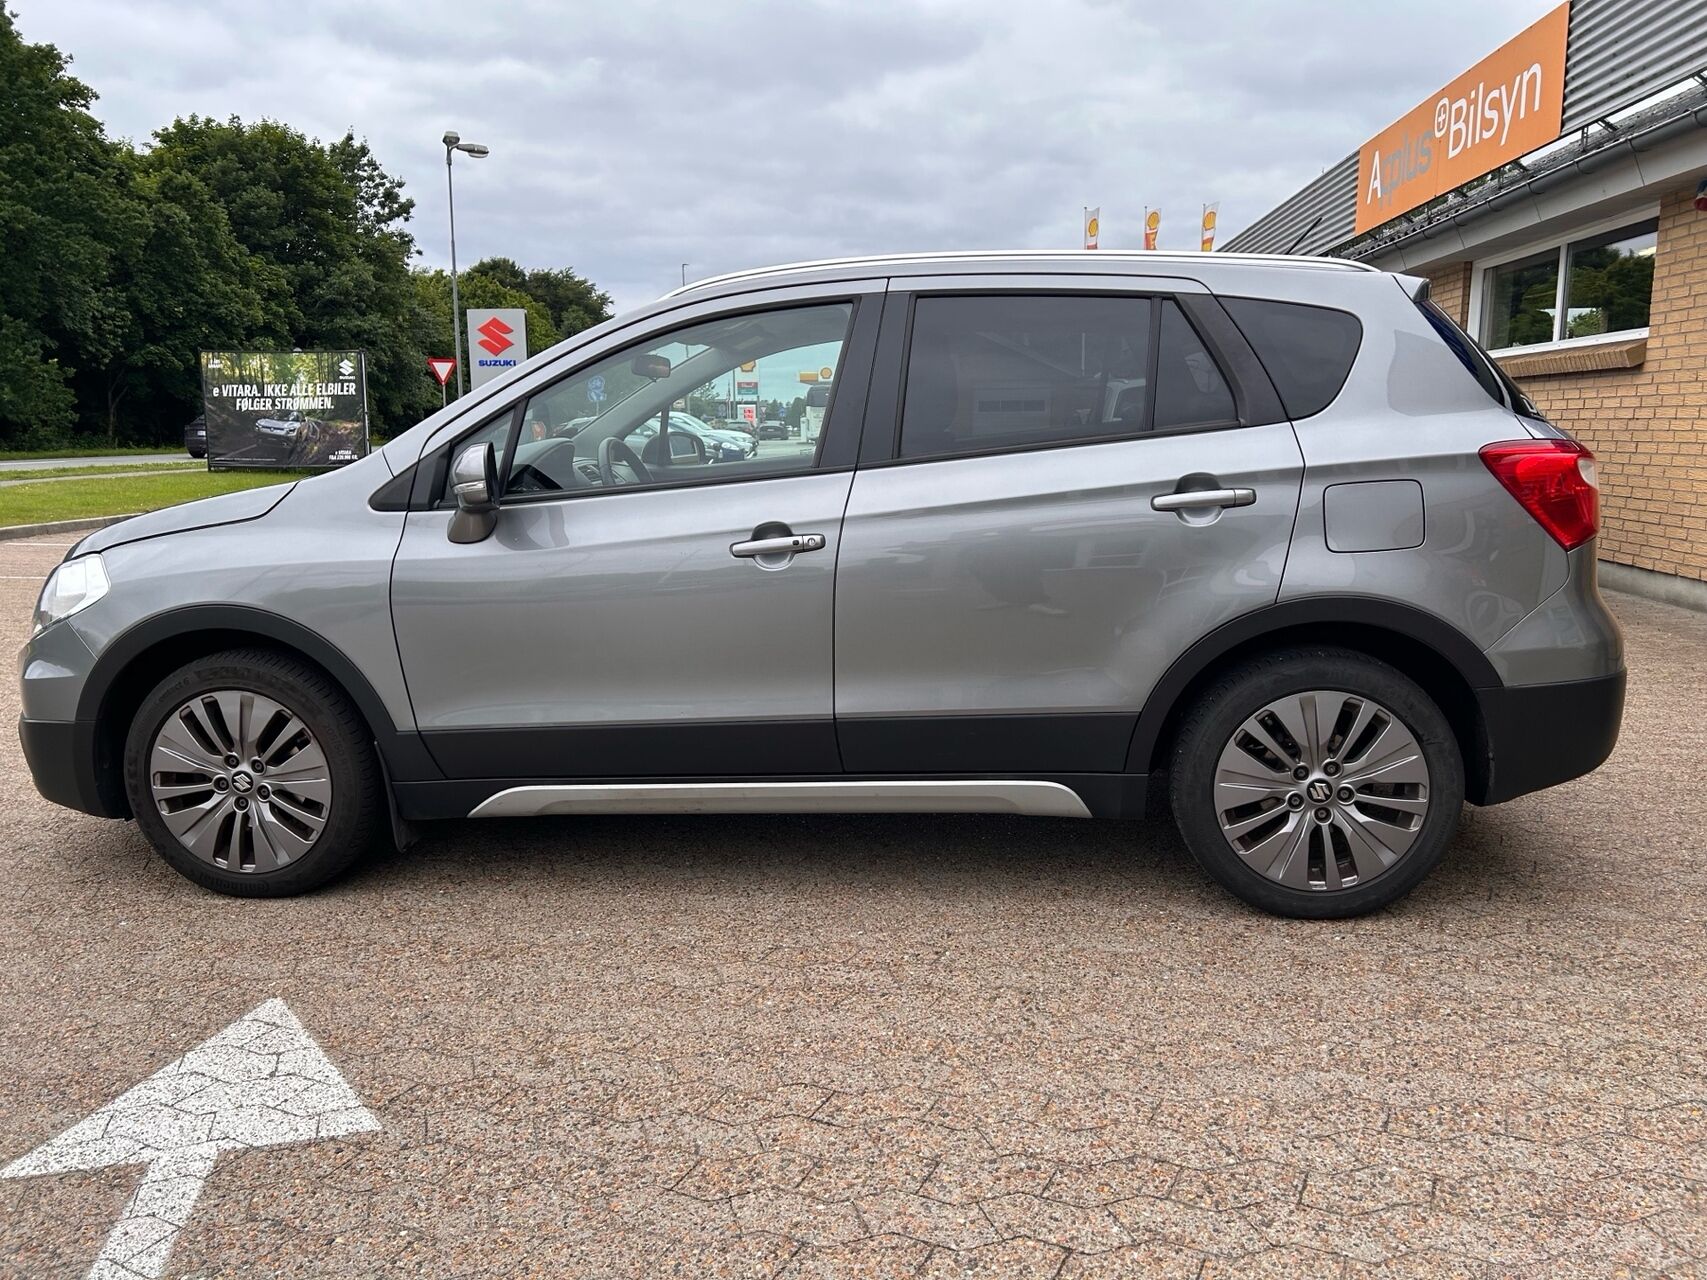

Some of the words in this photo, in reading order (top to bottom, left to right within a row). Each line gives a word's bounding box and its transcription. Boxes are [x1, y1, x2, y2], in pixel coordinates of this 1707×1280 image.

[1367, 130, 1433, 208] Applus
[1448, 63, 1542, 160] Bilsyn
[212, 388, 219, 397] e
[221, 384, 261, 397] VITARA.
[264, 384, 287, 396] IKKE
[289, 383, 314, 396] ALLE
[316, 383, 356, 395] ELBILER
[235, 398, 272, 411] FØLGER
[275, 397, 334, 411] STRØMMEN.
